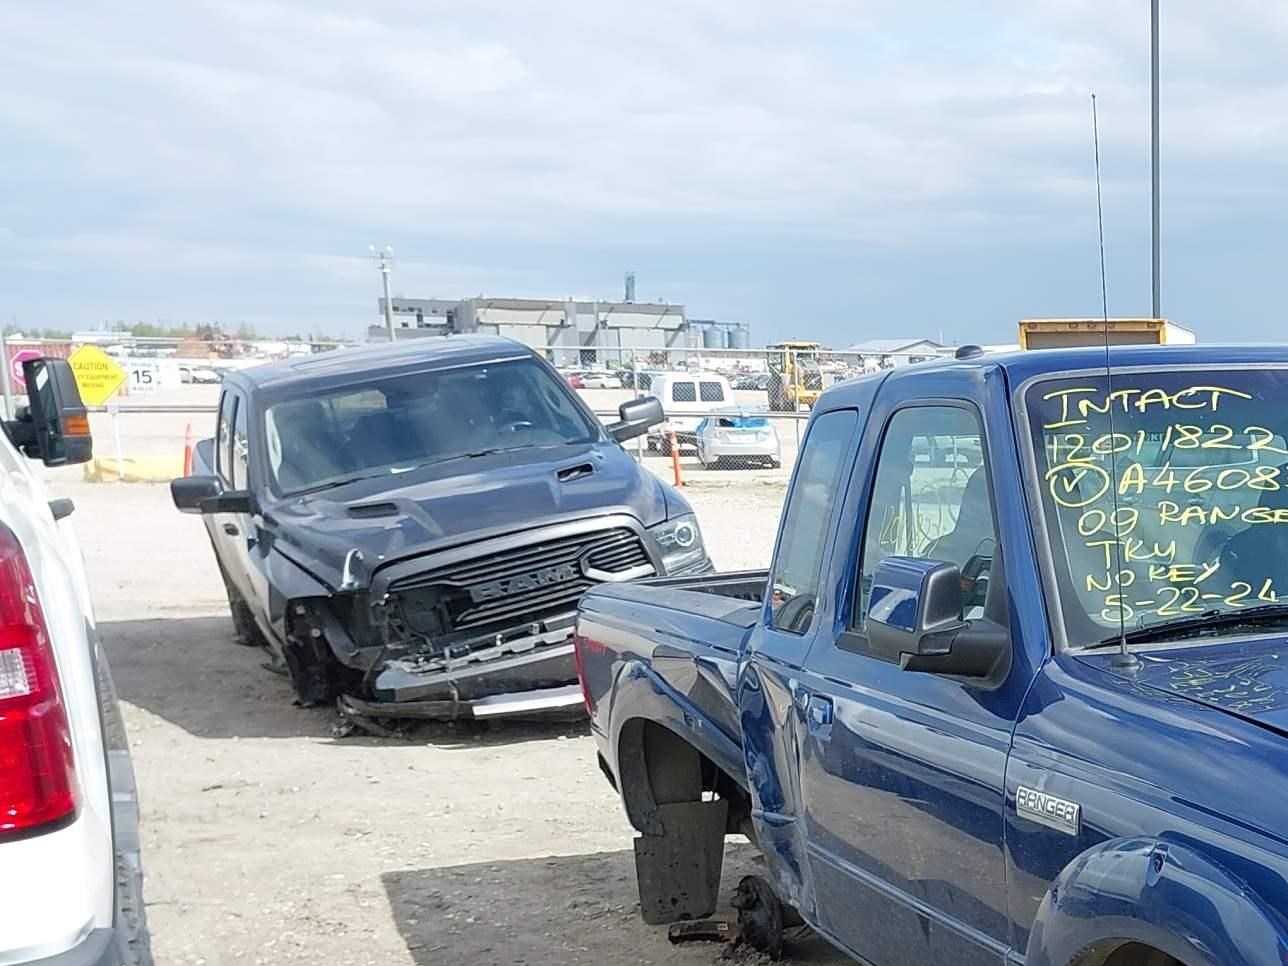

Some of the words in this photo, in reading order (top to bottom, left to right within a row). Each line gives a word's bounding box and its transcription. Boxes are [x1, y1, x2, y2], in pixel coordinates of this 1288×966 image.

[73, 362, 109, 370] CAUTION
[132, 370, 152, 384] 15
[1043, 386, 1252, 429] INTACT
[464, 560, 580, 602] RAM
[1086, 570, 1135, 592] NO
[1149, 556, 1221, 585] KEY
[1101, 578, 1280, 622] 5-22-24
[1018, 788, 1076, 823] RANGER
